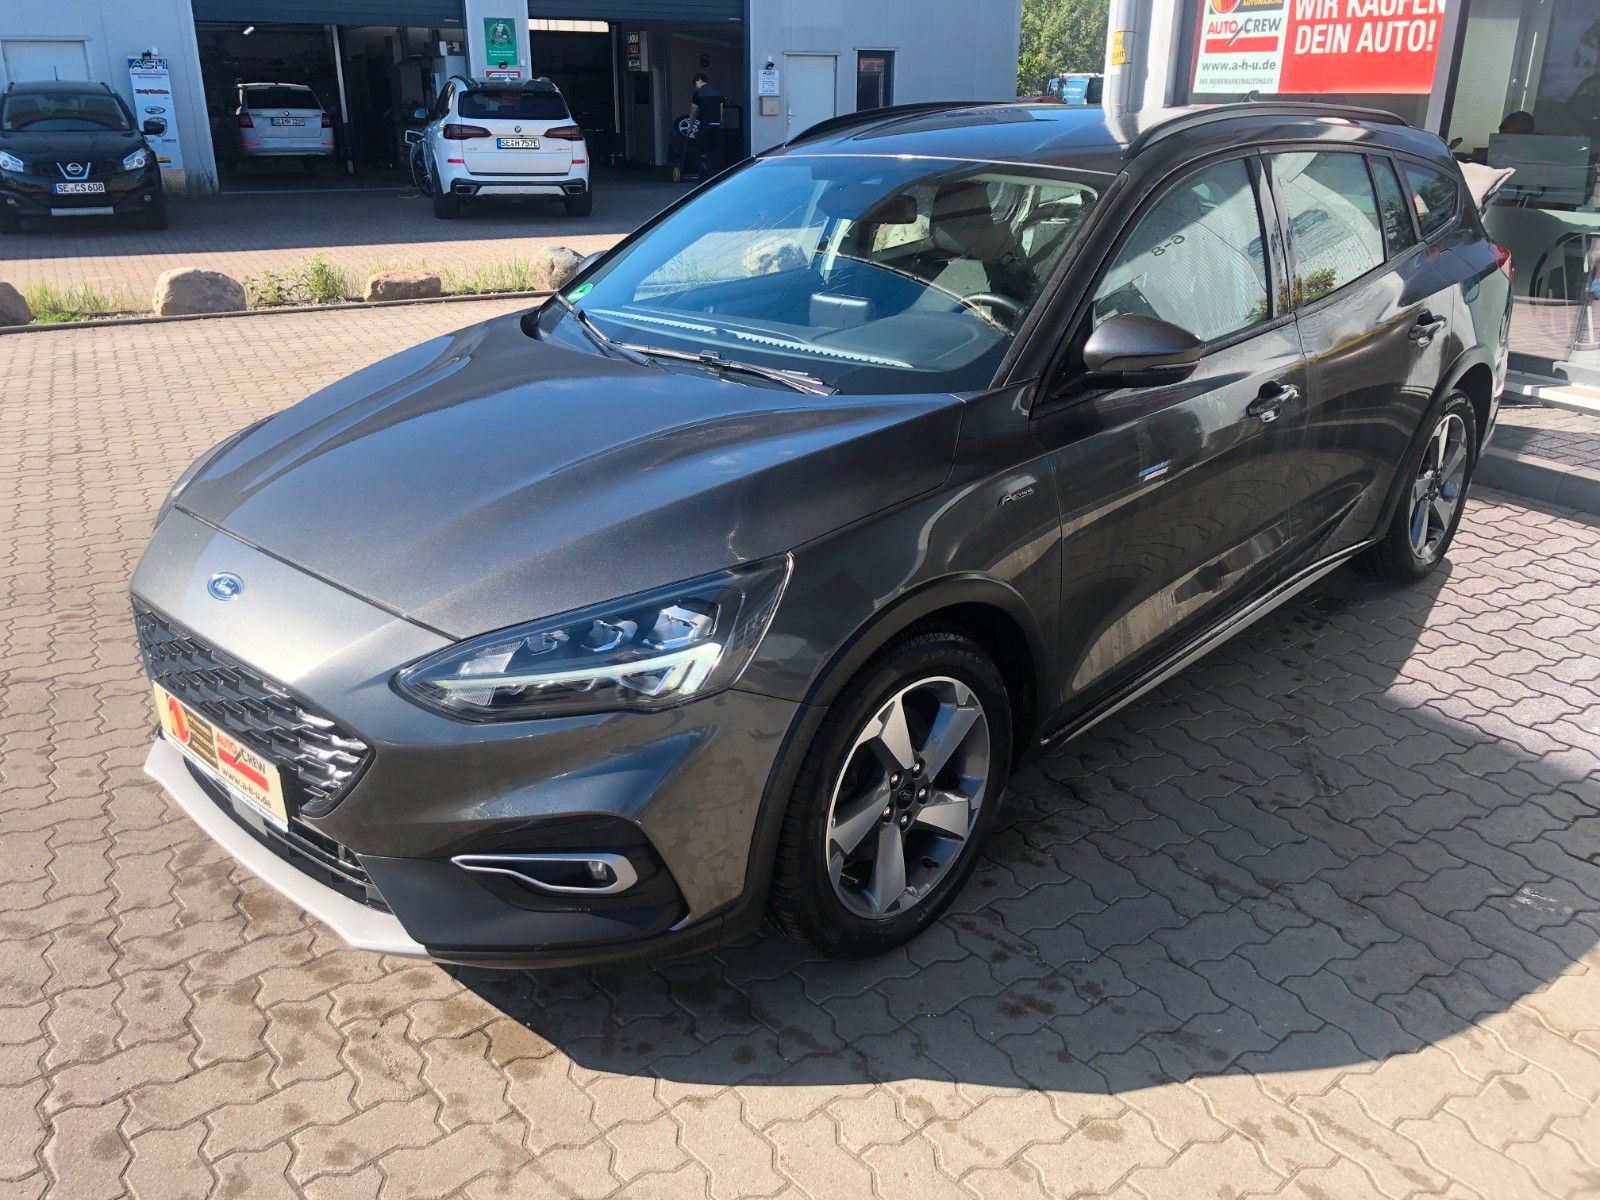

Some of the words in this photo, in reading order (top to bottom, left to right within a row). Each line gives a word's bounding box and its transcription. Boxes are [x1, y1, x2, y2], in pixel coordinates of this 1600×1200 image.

[1295, 0, 1338, 20] WIR
[1295, 23, 1352, 54] DEIN
[1356, 19, 1437, 53] AUTO!
[131, 59, 168, 69] ASH
[1202, 59, 1277, 71] www.a-h-u.de
